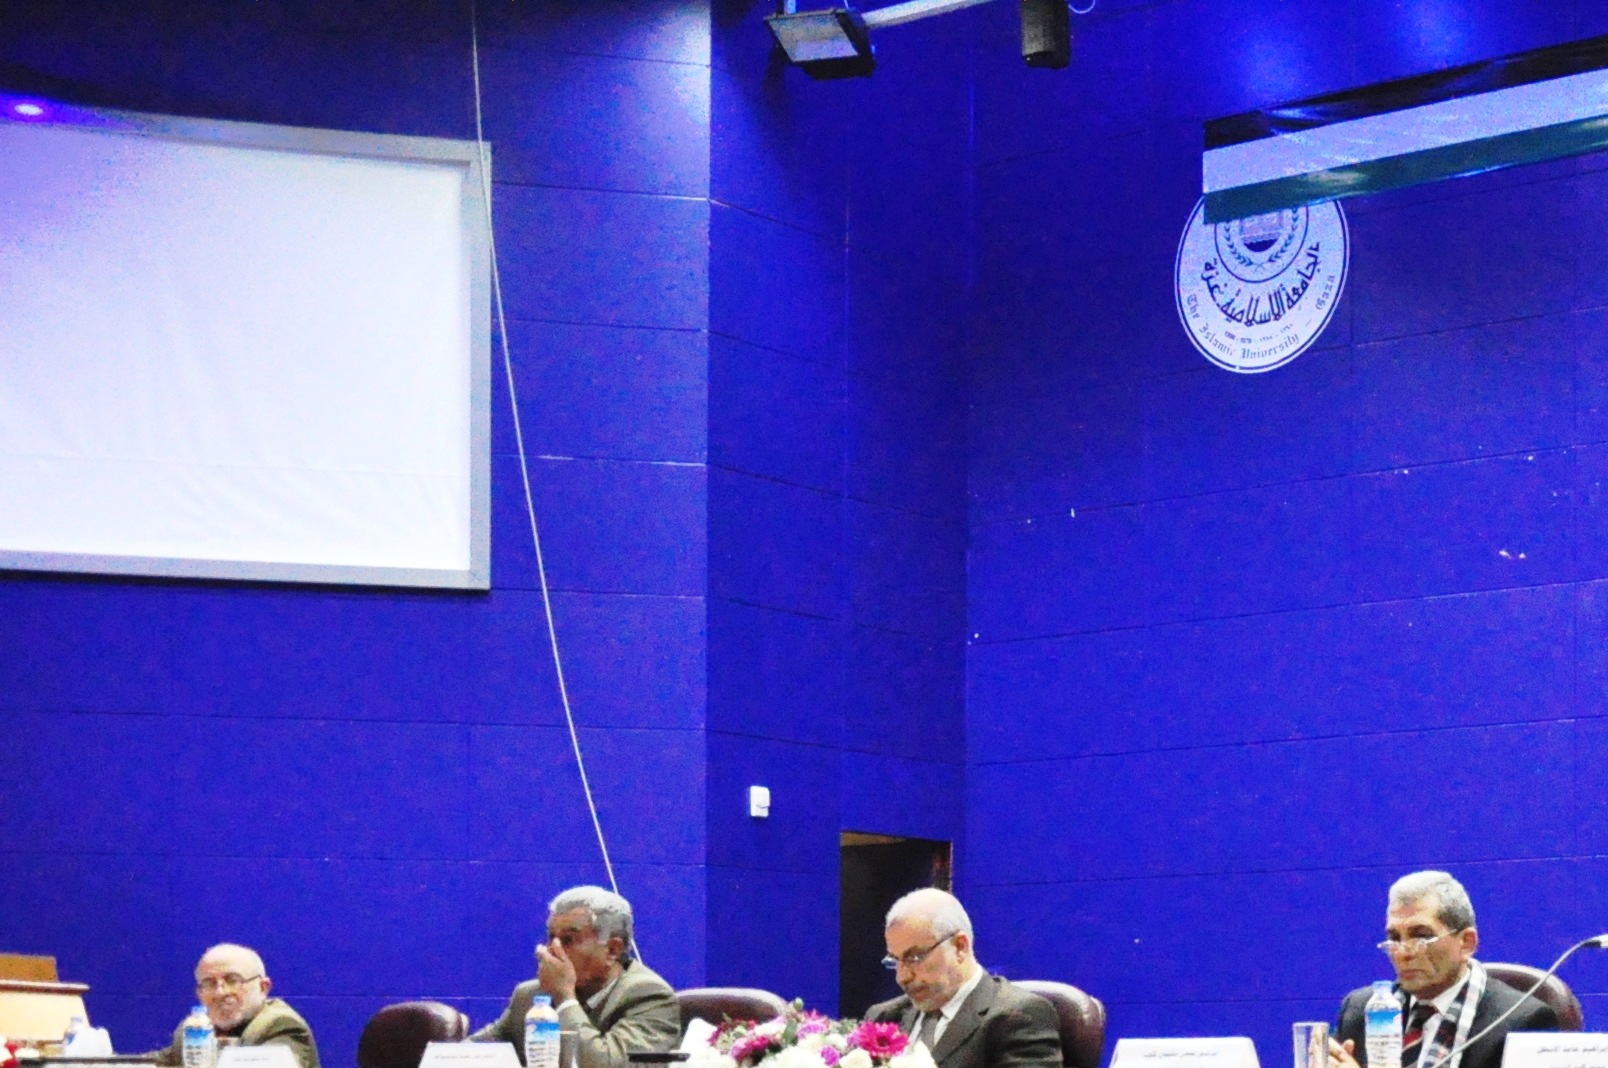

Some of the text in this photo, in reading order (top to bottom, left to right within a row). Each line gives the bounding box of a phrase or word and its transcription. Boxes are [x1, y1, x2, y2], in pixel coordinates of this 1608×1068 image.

[1186, 293, 1201, 320] The
[1199, 322, 1236, 357] Islamic
[1241, 333, 1300, 360] University
